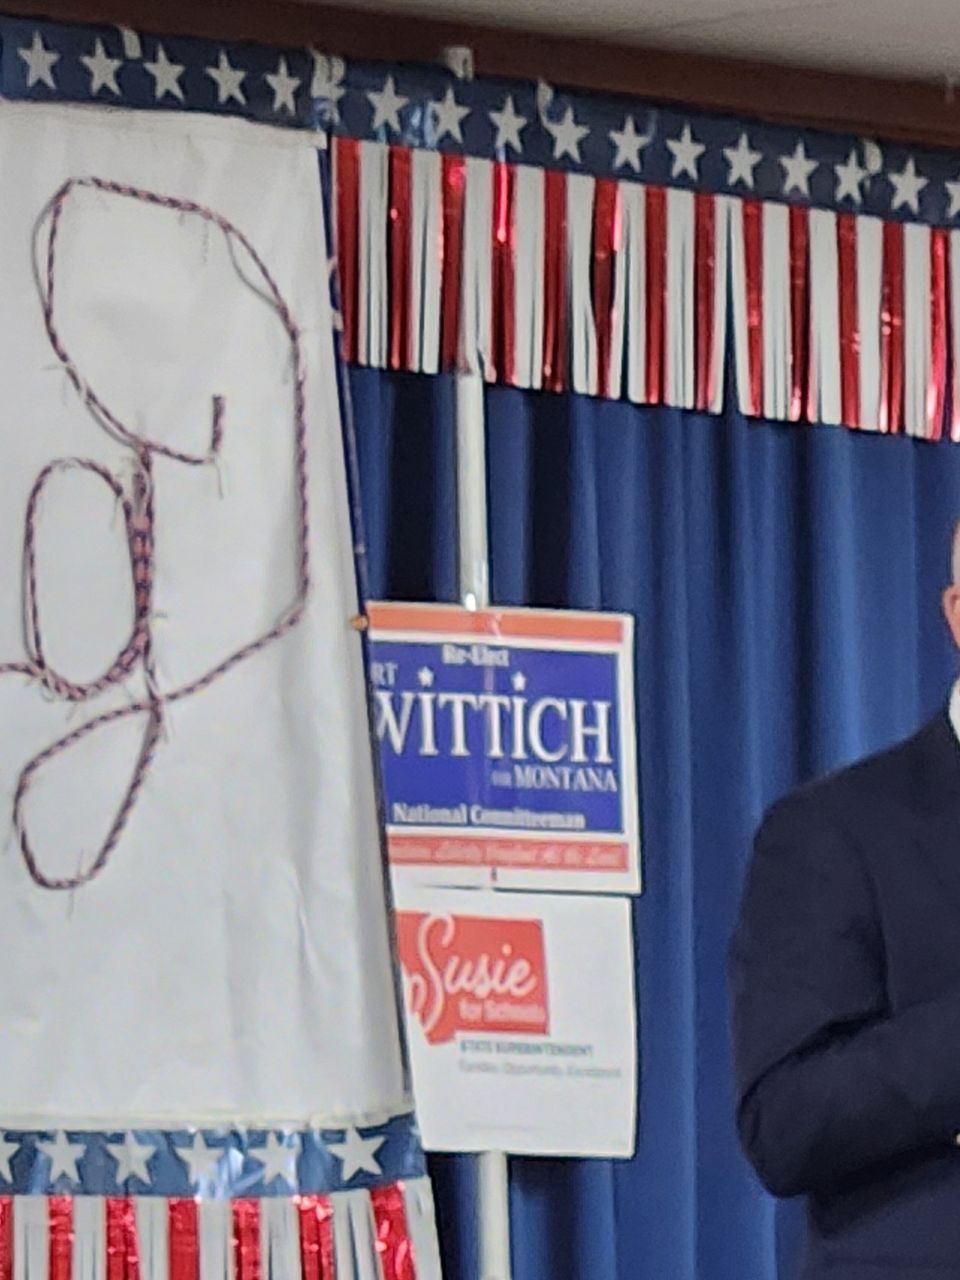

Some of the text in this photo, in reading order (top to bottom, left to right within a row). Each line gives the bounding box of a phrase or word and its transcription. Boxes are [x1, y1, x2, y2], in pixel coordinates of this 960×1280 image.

[370, 662, 398, 685] RT
[513, 765, 618, 792] MONTANA
[393, 803, 467, 824] National
[405, 914, 537, 1031] Susie
